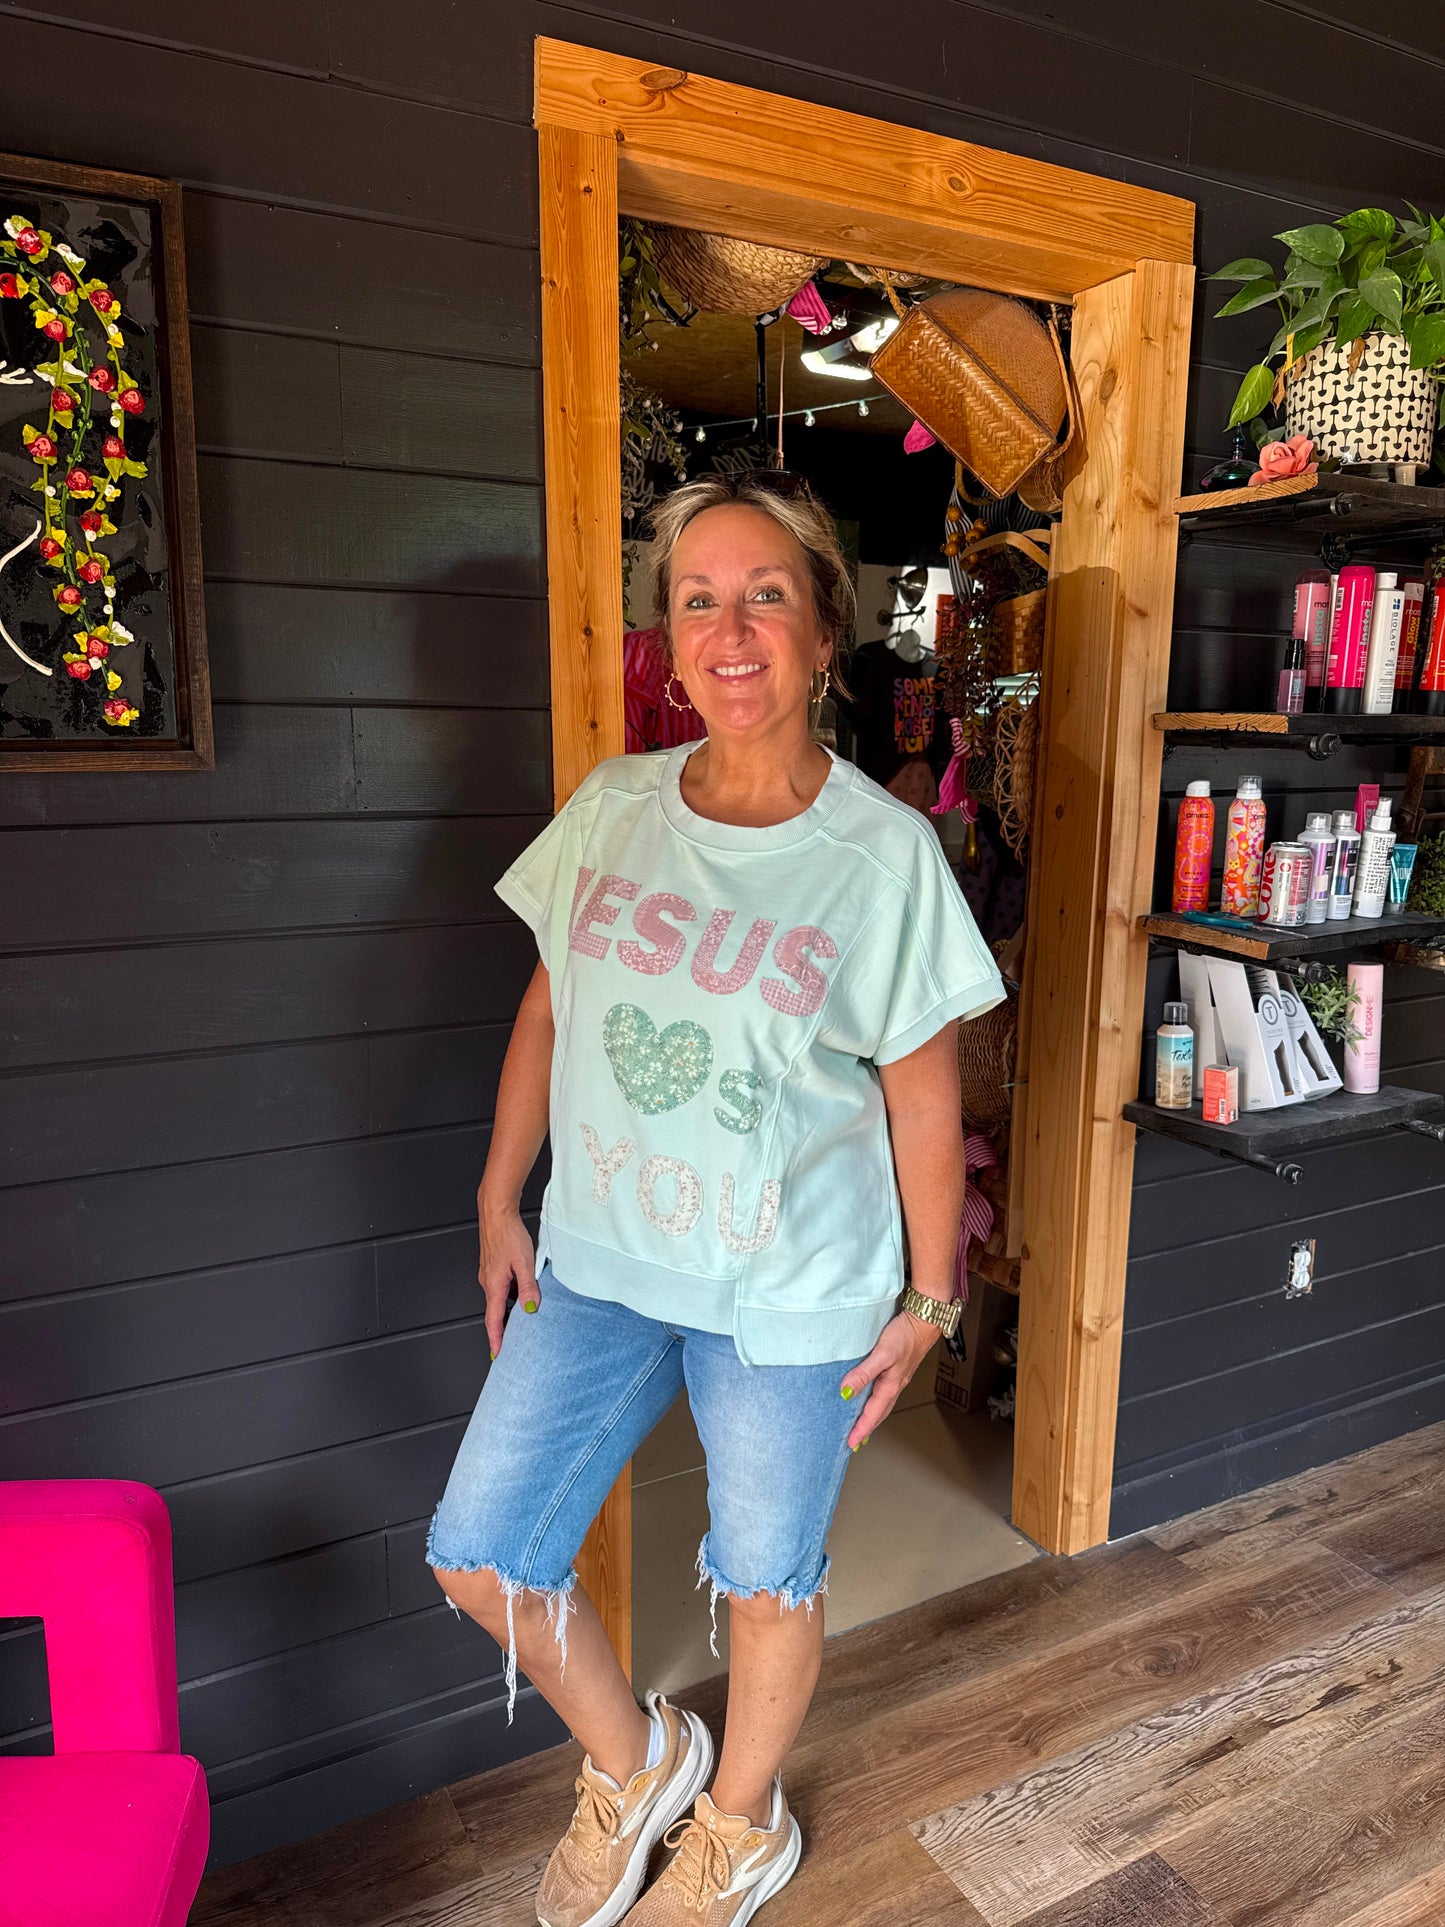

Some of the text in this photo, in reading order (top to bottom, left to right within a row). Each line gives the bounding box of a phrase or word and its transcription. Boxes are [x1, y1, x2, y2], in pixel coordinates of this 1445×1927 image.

[1312, 609, 1325, 646] Insta
[1389, 611, 1399, 653] BIOLAGE
[1406, 615, 1417, 644] Glow
[1257, 851, 1277, 922] Coke
[578, 1120, 782, 1256] YOU
